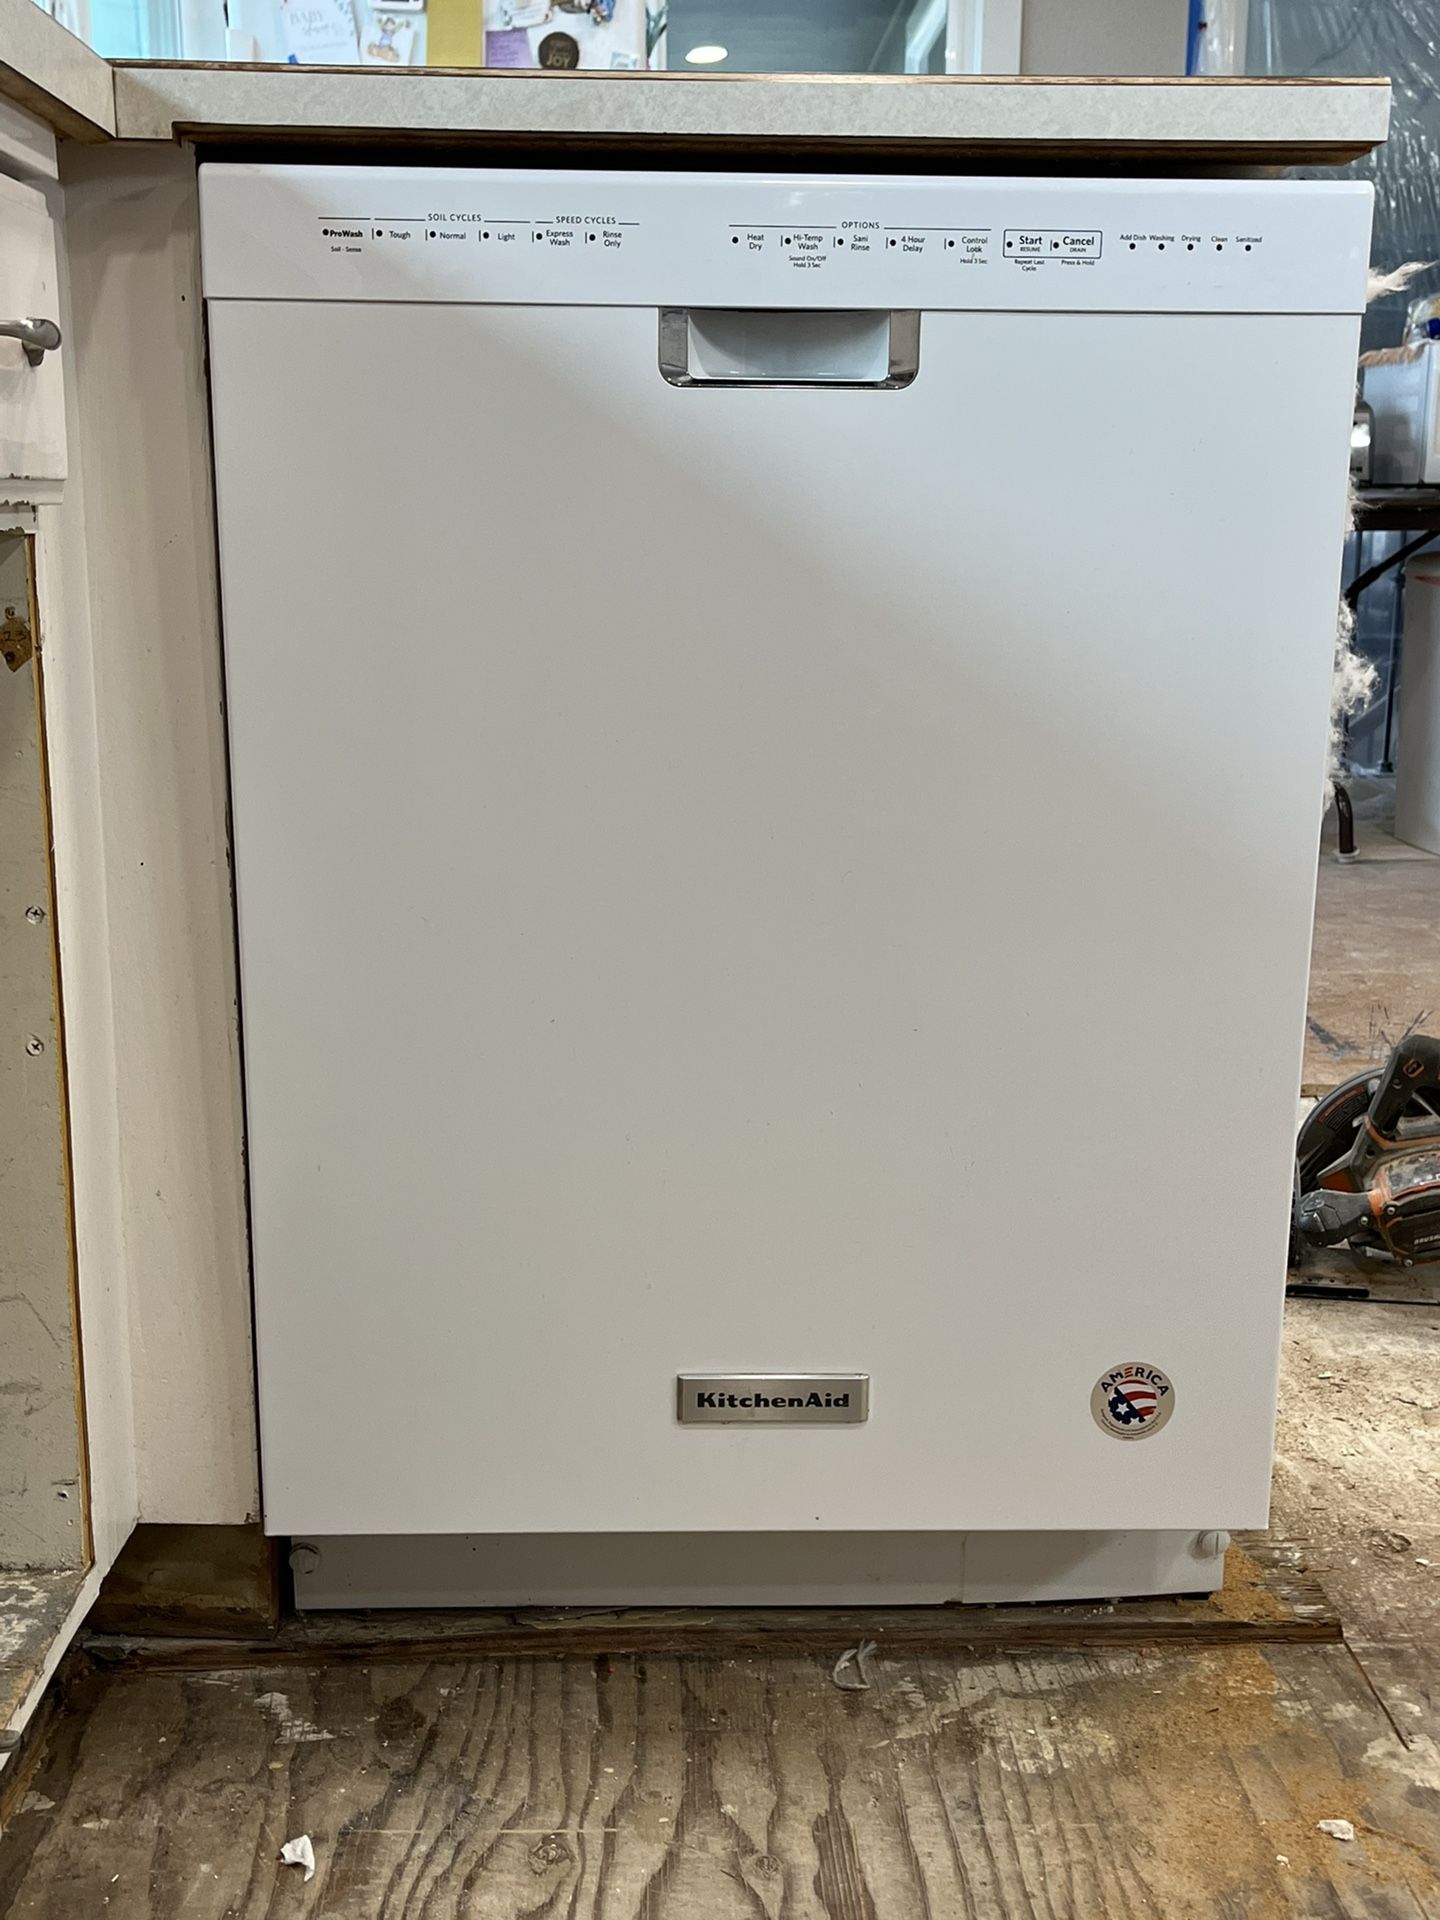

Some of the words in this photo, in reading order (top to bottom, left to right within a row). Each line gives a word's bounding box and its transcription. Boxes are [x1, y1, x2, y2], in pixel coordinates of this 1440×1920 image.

[546, 53, 571, 68] JOY
[428, 213, 447, 222] SOIL
[450, 213, 482, 222] CYCLES
[556, 216, 582, 224] SPEED
[584, 216, 616, 225] CYCLES
[841, 221, 880, 229] OPTIONS
[329, 229, 363, 238] ProWash
[389, 230, 411, 240] Tough
[439, 231, 466, 239] Normal
[497, 233, 515, 241] Light
[546, 230, 573, 238] Express
[602, 230, 622, 238] Rinse
[747, 233, 764, 241] Heat
[550, 238, 570, 246] Wash
[793, 234, 823, 243] Hi-Temp
[853, 234, 868, 242] Sani
[961, 236, 988, 244] Control
[1019, 235, 1042, 245] Start
[1063, 236, 1095, 246] Cancel
[1149, 234, 1175, 242] Washing
[604, 239, 621, 248] Only
[749, 242, 762, 251] Dry
[850, 243, 870, 251] Rinse
[902, 245, 923, 253] Delay
[1101, 1366, 1170, 1397] AMERICA
[697, 1392, 849, 1408] KitchenAid
